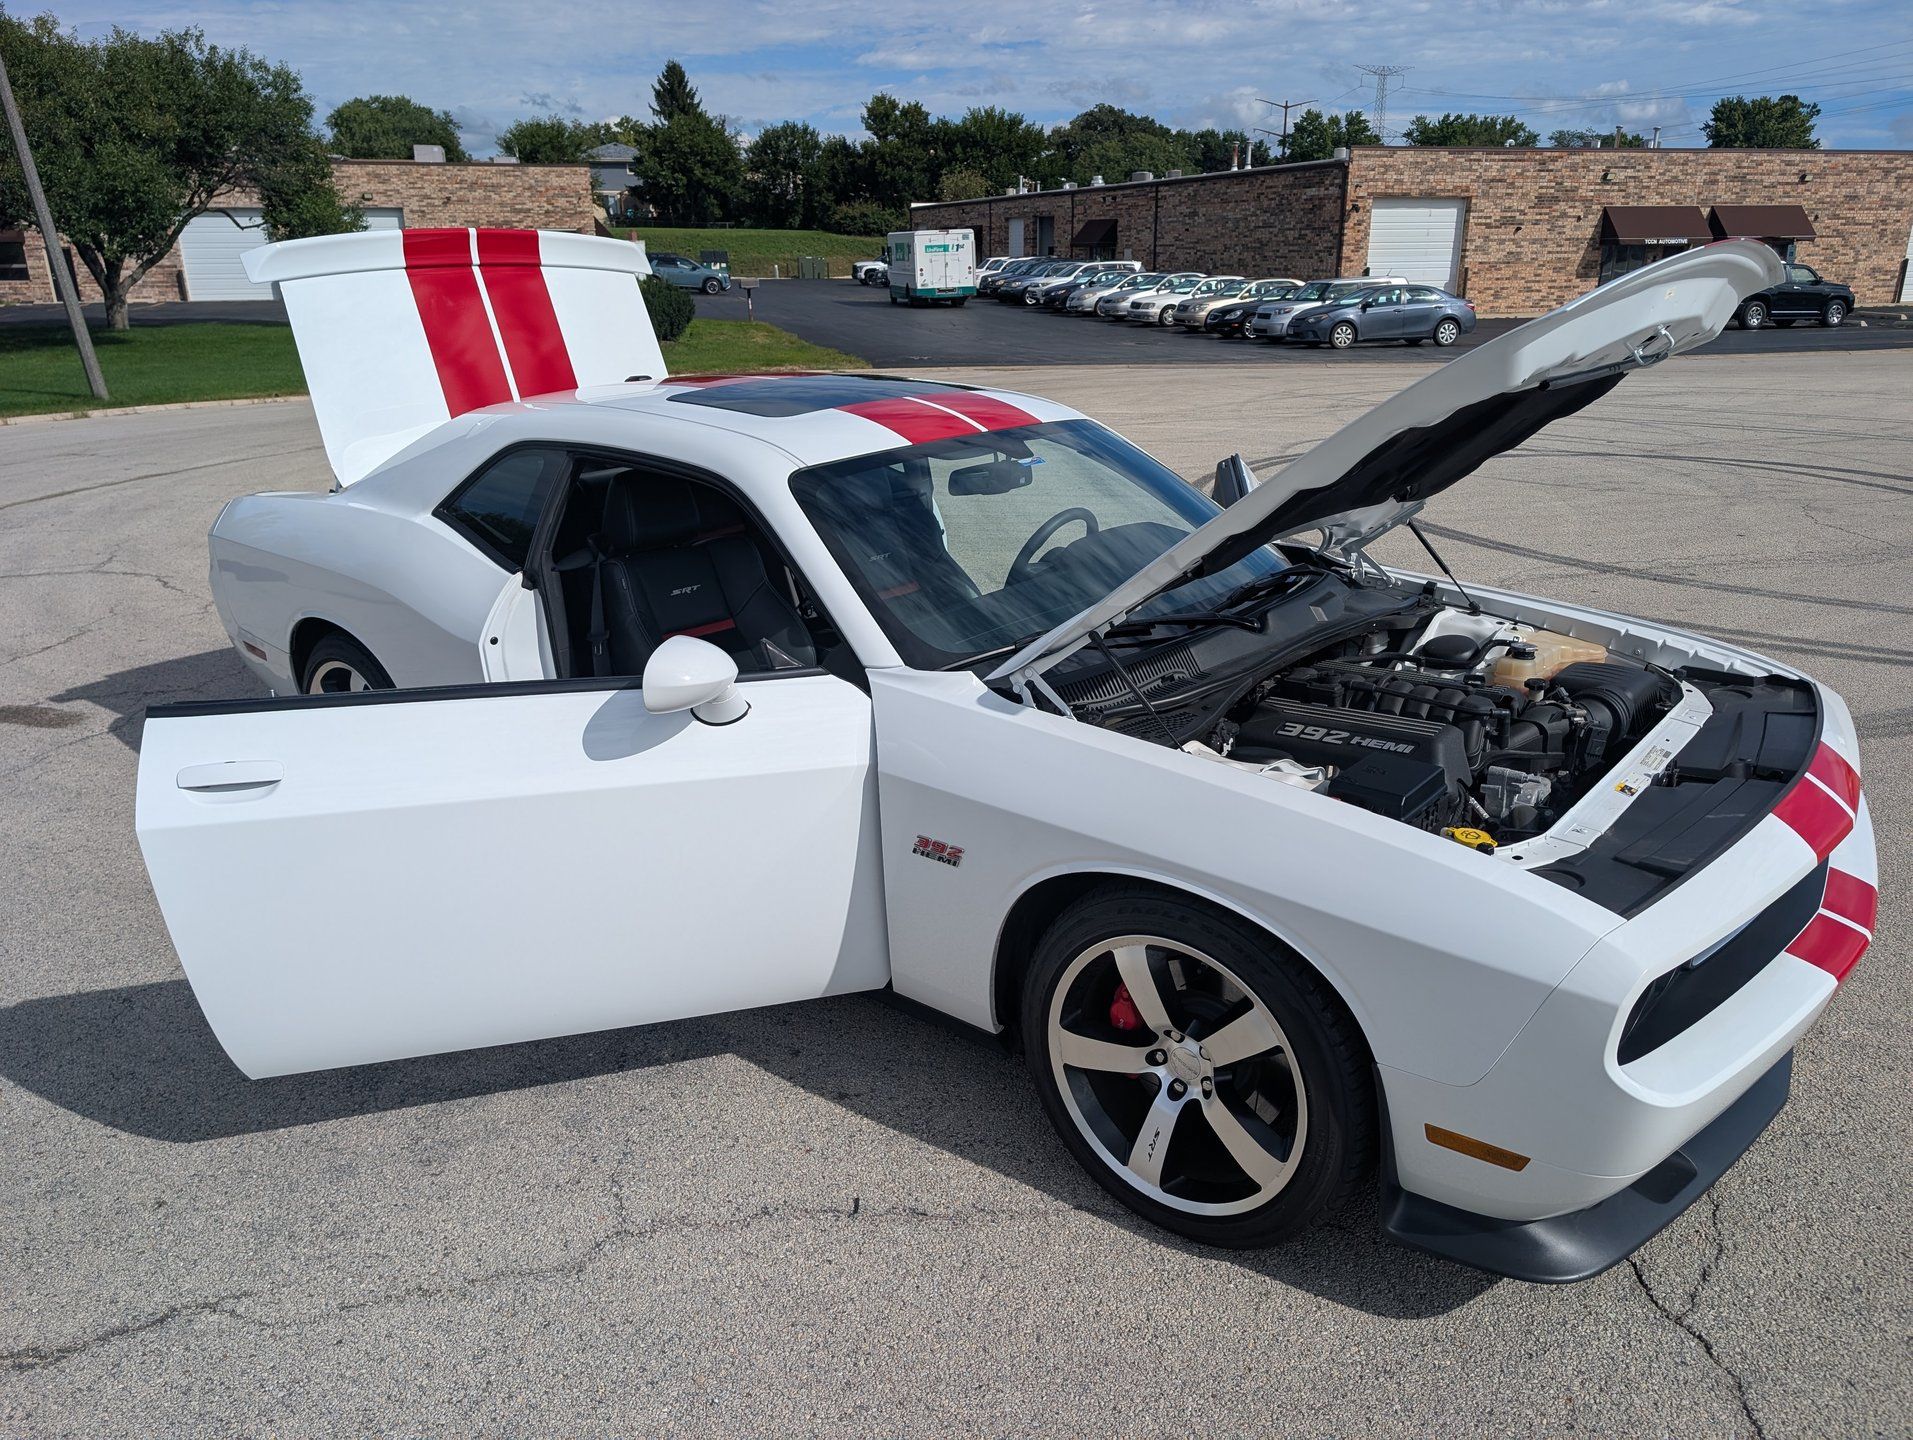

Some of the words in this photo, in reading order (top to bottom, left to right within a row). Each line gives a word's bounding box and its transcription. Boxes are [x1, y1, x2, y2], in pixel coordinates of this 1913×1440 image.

[670, 584, 701, 596] SRT
[1276, 722, 1351, 745] 392
[1349, 736, 1415, 754] HEMI
[912, 846, 961, 868] HEMI
[913, 834, 965, 861] 392
[1147, 1126, 1161, 1163] SRT
